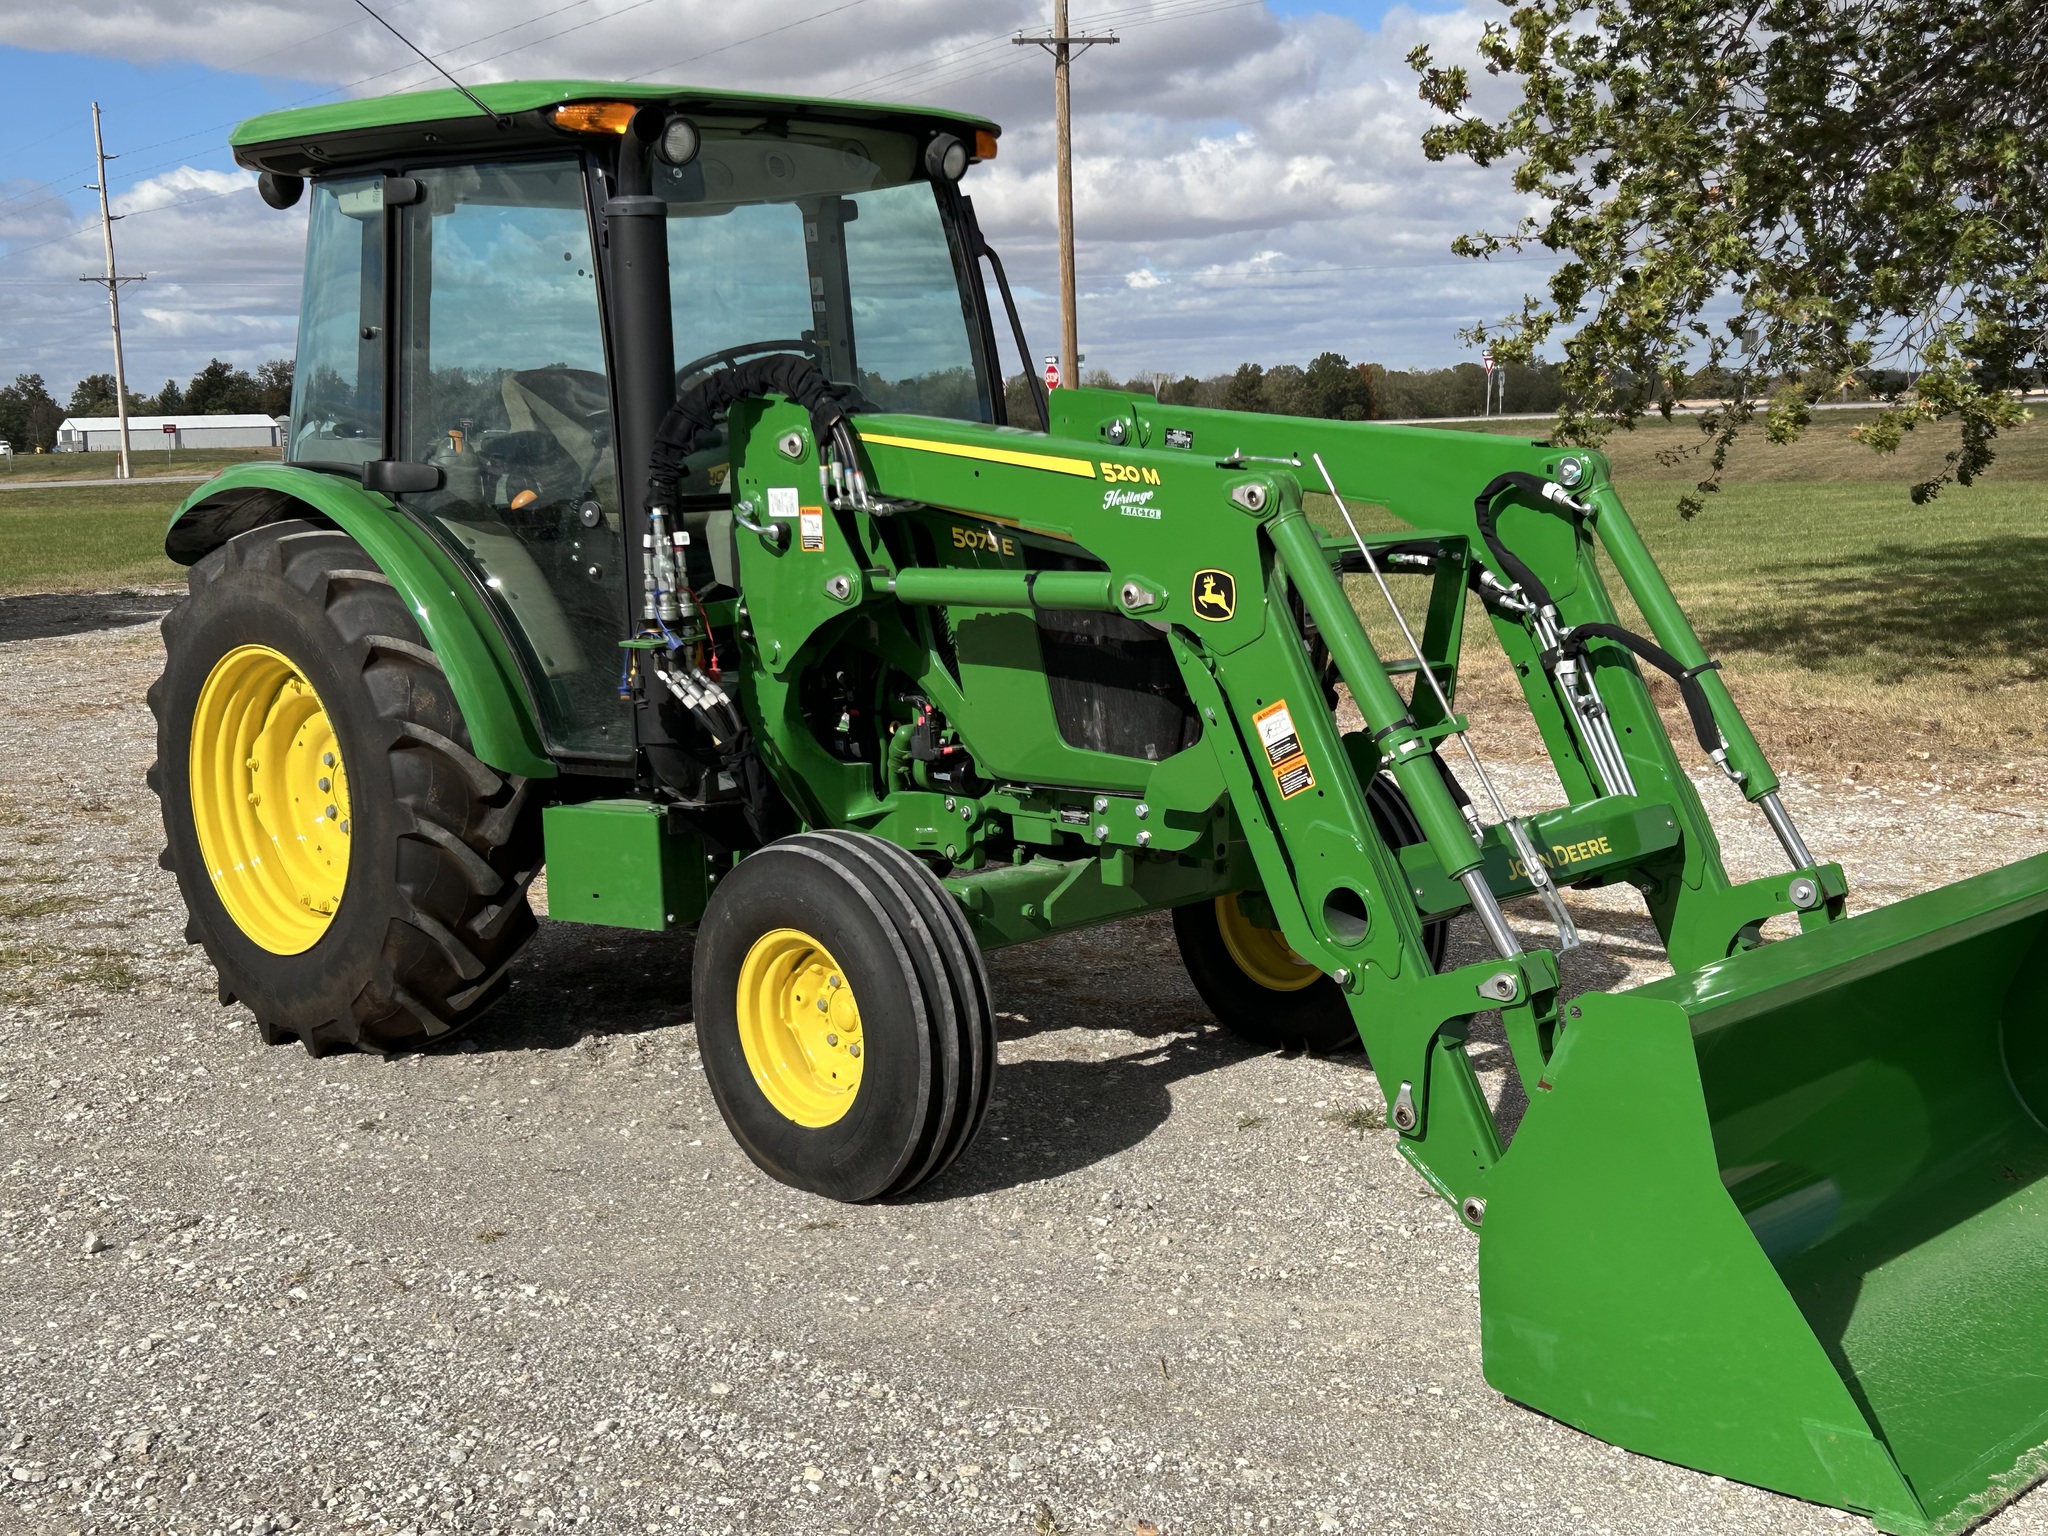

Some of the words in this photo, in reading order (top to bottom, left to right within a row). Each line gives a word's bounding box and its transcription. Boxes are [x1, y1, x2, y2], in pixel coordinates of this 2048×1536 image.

[1100, 462, 1141, 483] 520
[1141, 467, 1161, 486] M
[1102, 489, 1154, 510] Heritage
[1121, 505, 1161, 520] TRACTOR
[952, 526, 999, 553] 5075
[1002, 537, 1015, 556] E
[1508, 852, 1554, 881] JON
[1553, 836, 1613, 866] DEERE
